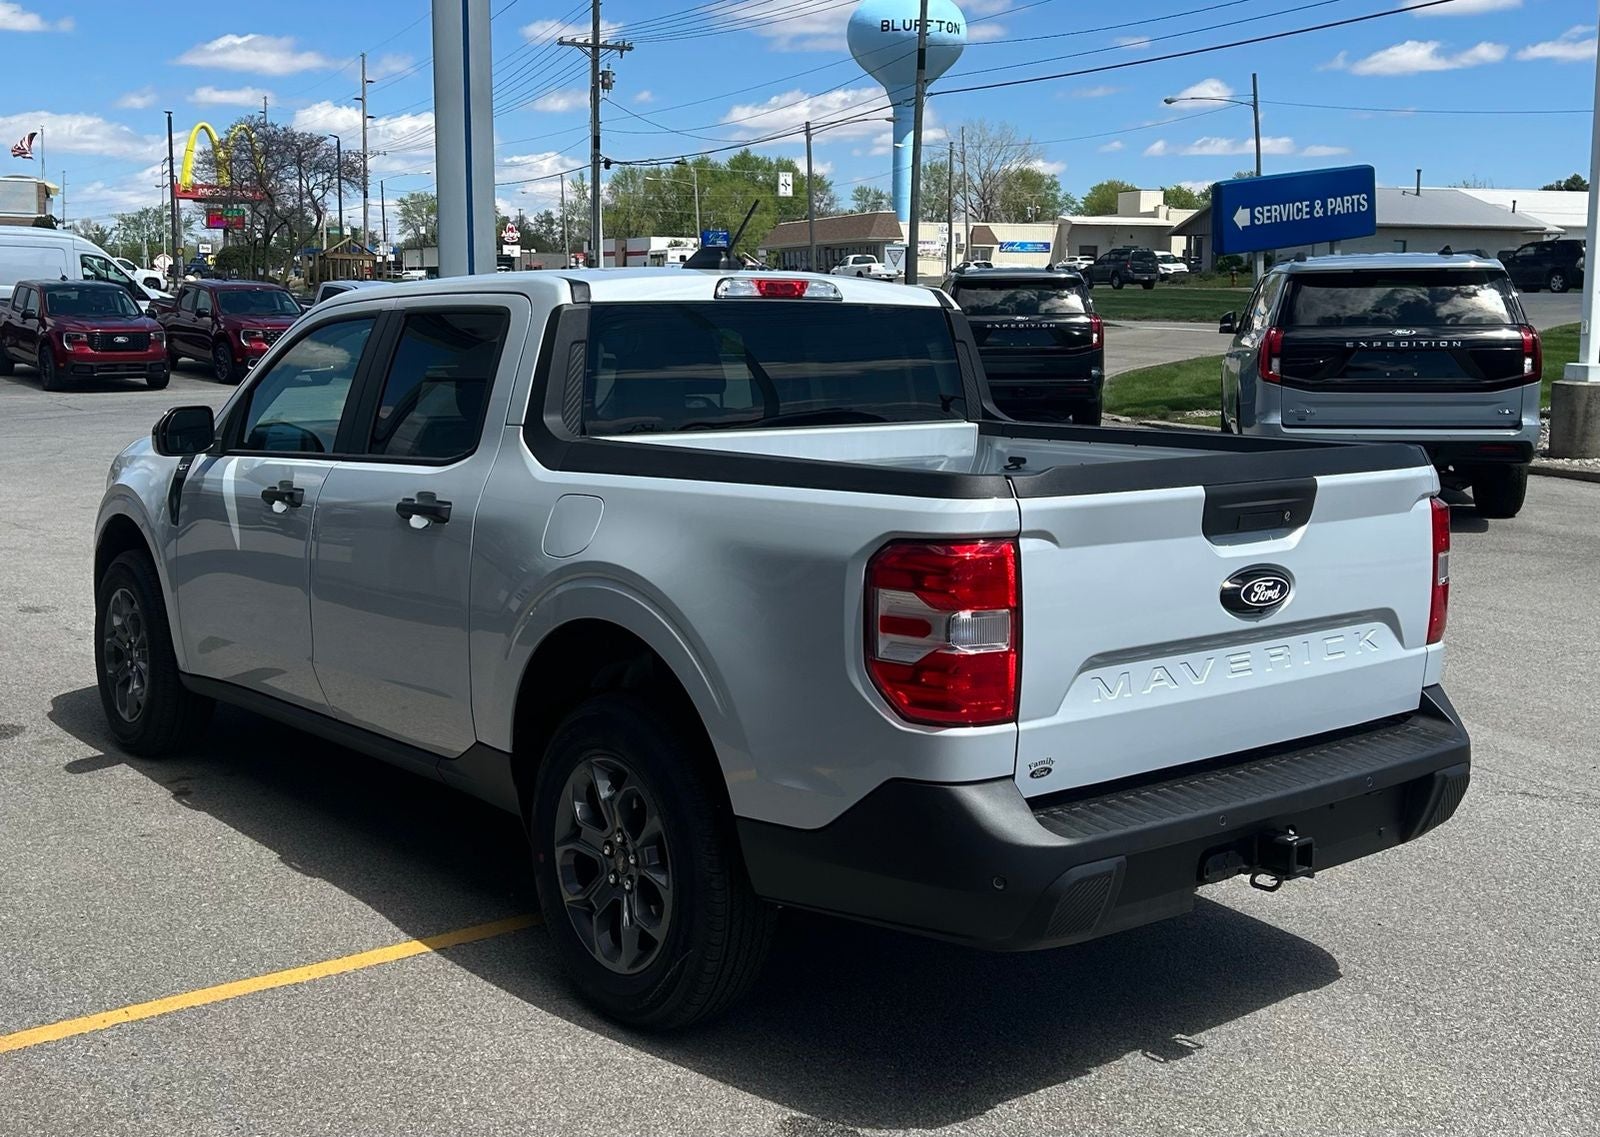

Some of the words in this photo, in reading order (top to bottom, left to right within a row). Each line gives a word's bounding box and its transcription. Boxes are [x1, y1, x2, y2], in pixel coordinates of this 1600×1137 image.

[881, 19, 960, 35] BLUFFTON
[1254, 201, 1310, 225] SERVICE
[1313, 200, 1324, 218] &
[1327, 193, 1368, 216] PARTS
[1250, 581, 1281, 602] Ford
[1090, 628, 1380, 703] MAVERICK
[1028, 757, 1055, 770] Family
